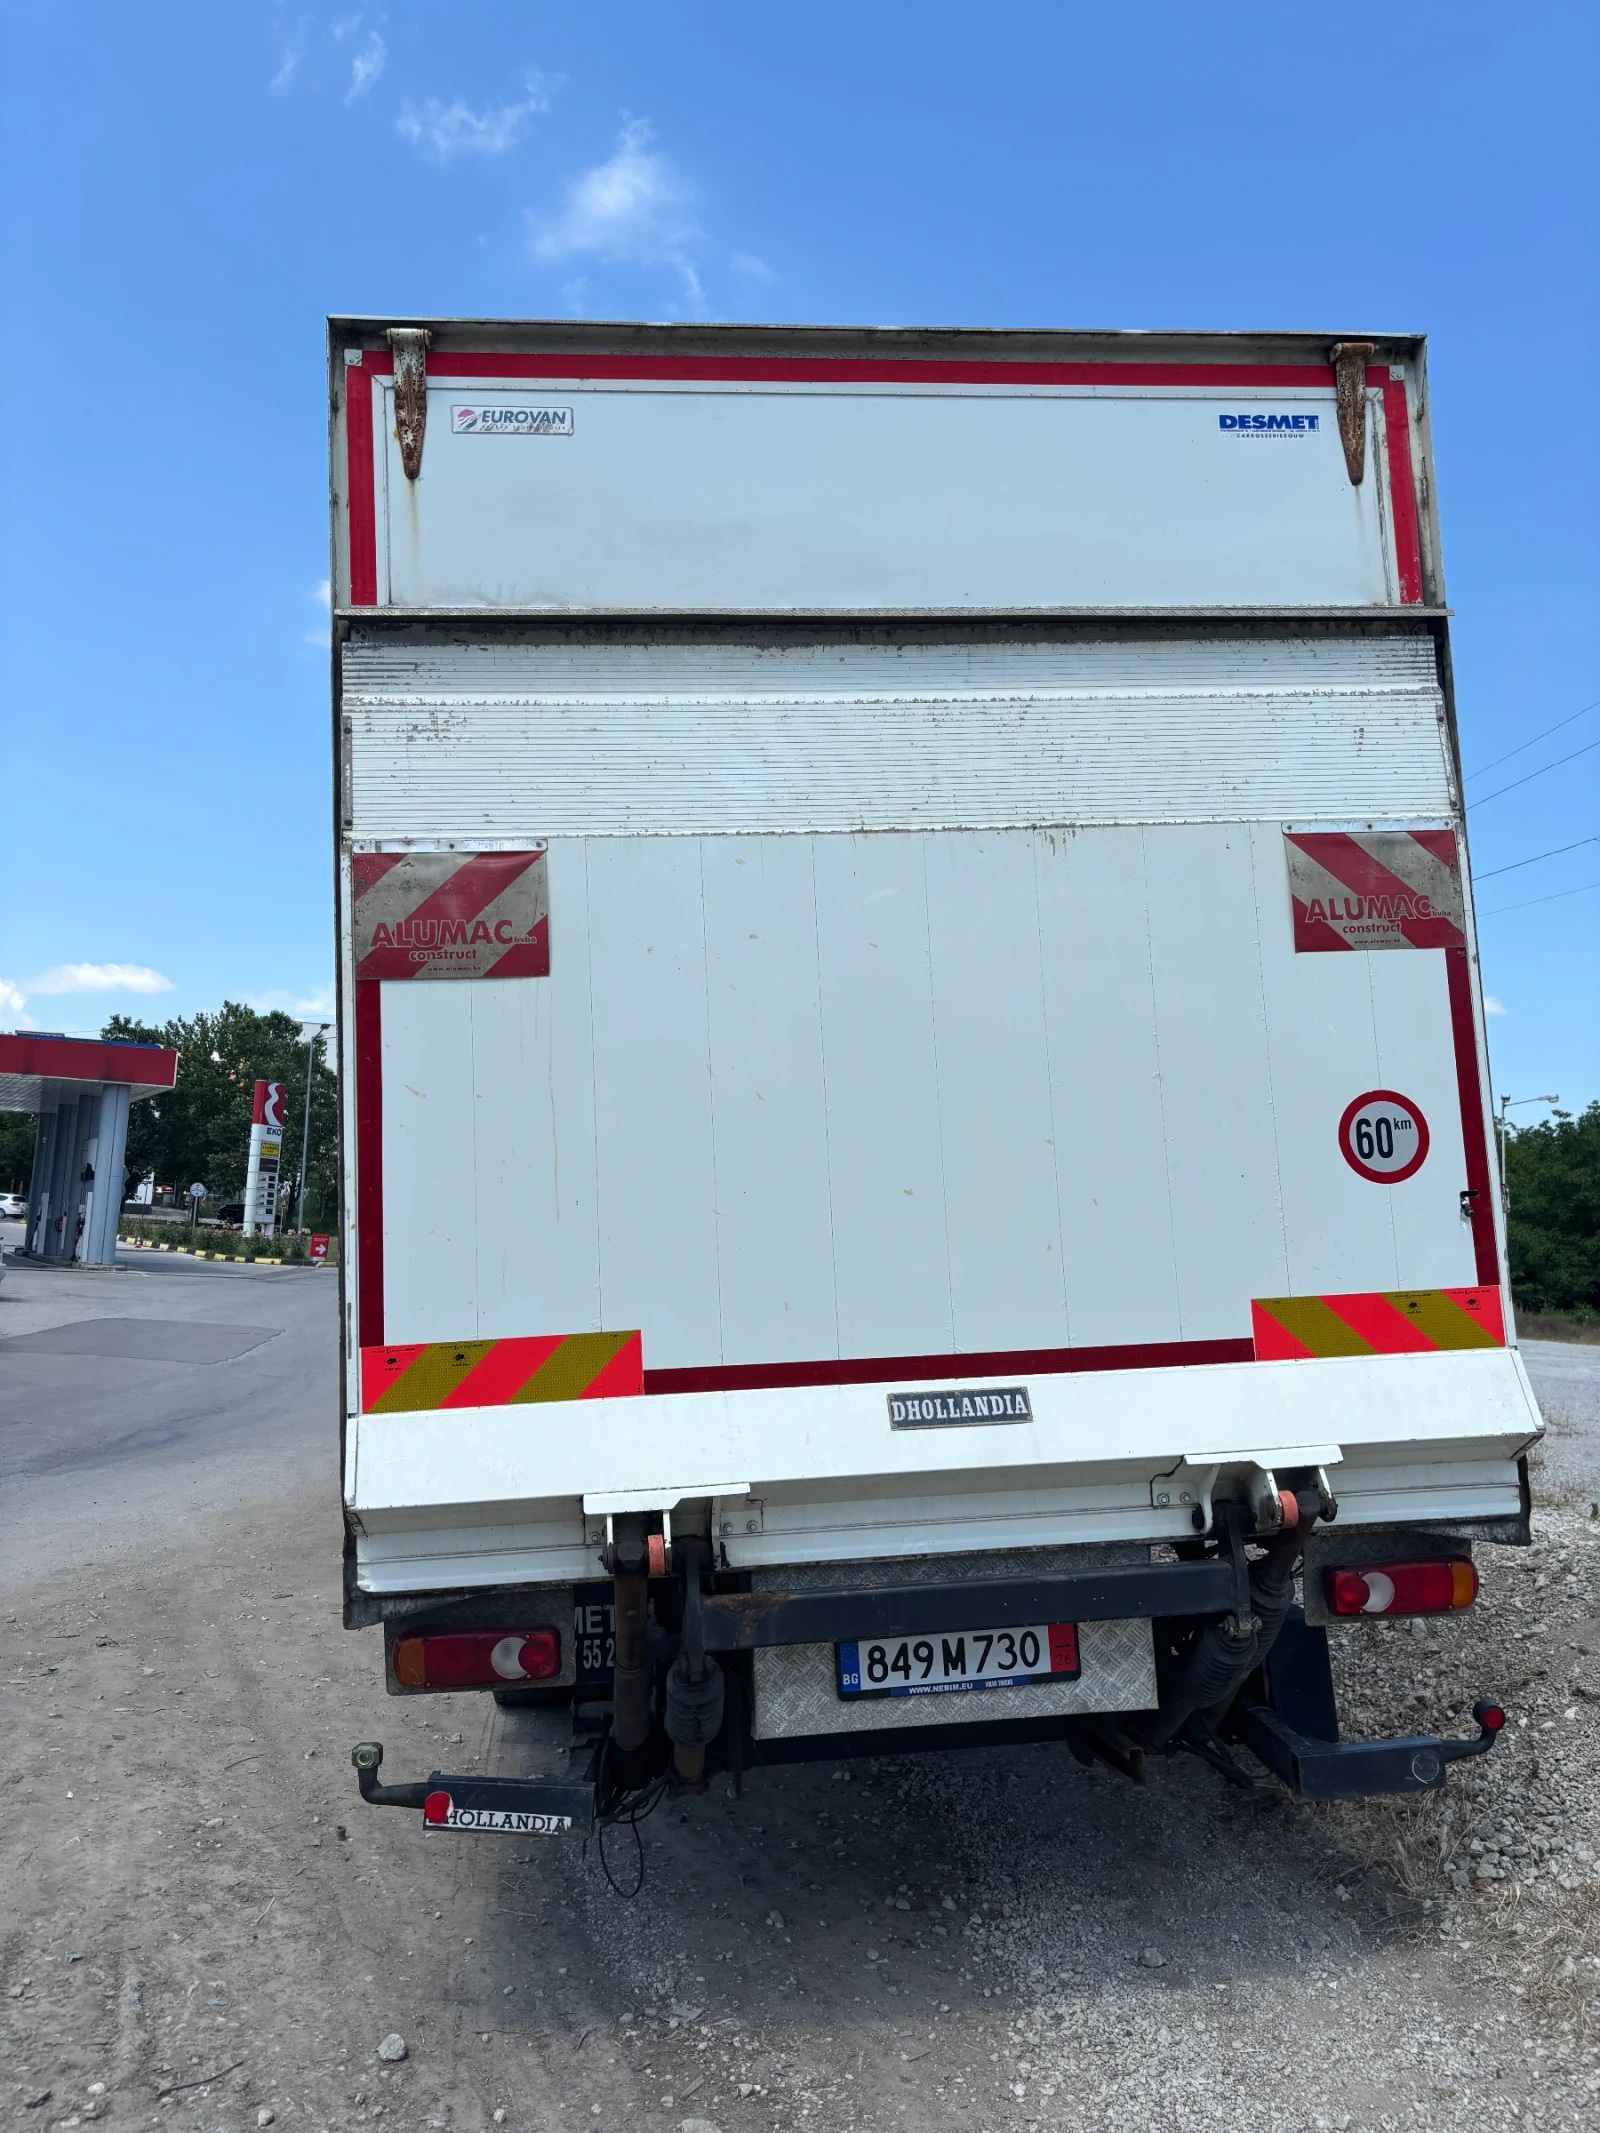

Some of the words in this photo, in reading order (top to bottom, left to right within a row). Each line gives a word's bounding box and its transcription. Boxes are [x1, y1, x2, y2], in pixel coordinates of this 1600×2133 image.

[482, 410, 566, 424] EUROVAN
[1219, 415, 1319, 429] DESMET
[1306, 895, 1431, 922] ALUMAC
[1431, 908, 1452, 917] bvba
[371, 920, 513, 948] ALUMAC
[514, 935, 537, 943] bvba
[1342, 921, 1402, 934] construct
[409, 948, 477, 961] construct
[266, 1127, 282, 1136] EKO
[1355, 1117, 1394, 1159] 60
[1393, 1117, 1412, 1130] km
[892, 1394, 1028, 1421] DHOLLANDIA
[1056, 1652, 1072, 1665] 26
[843, 1673, 859, 1685] BG
[908, 1683, 973, 1695] WWW.NEBIM.EU
[985, 1680, 997, 1688] VOLVO
[429, 1810, 566, 1832] HOLLANDIA
